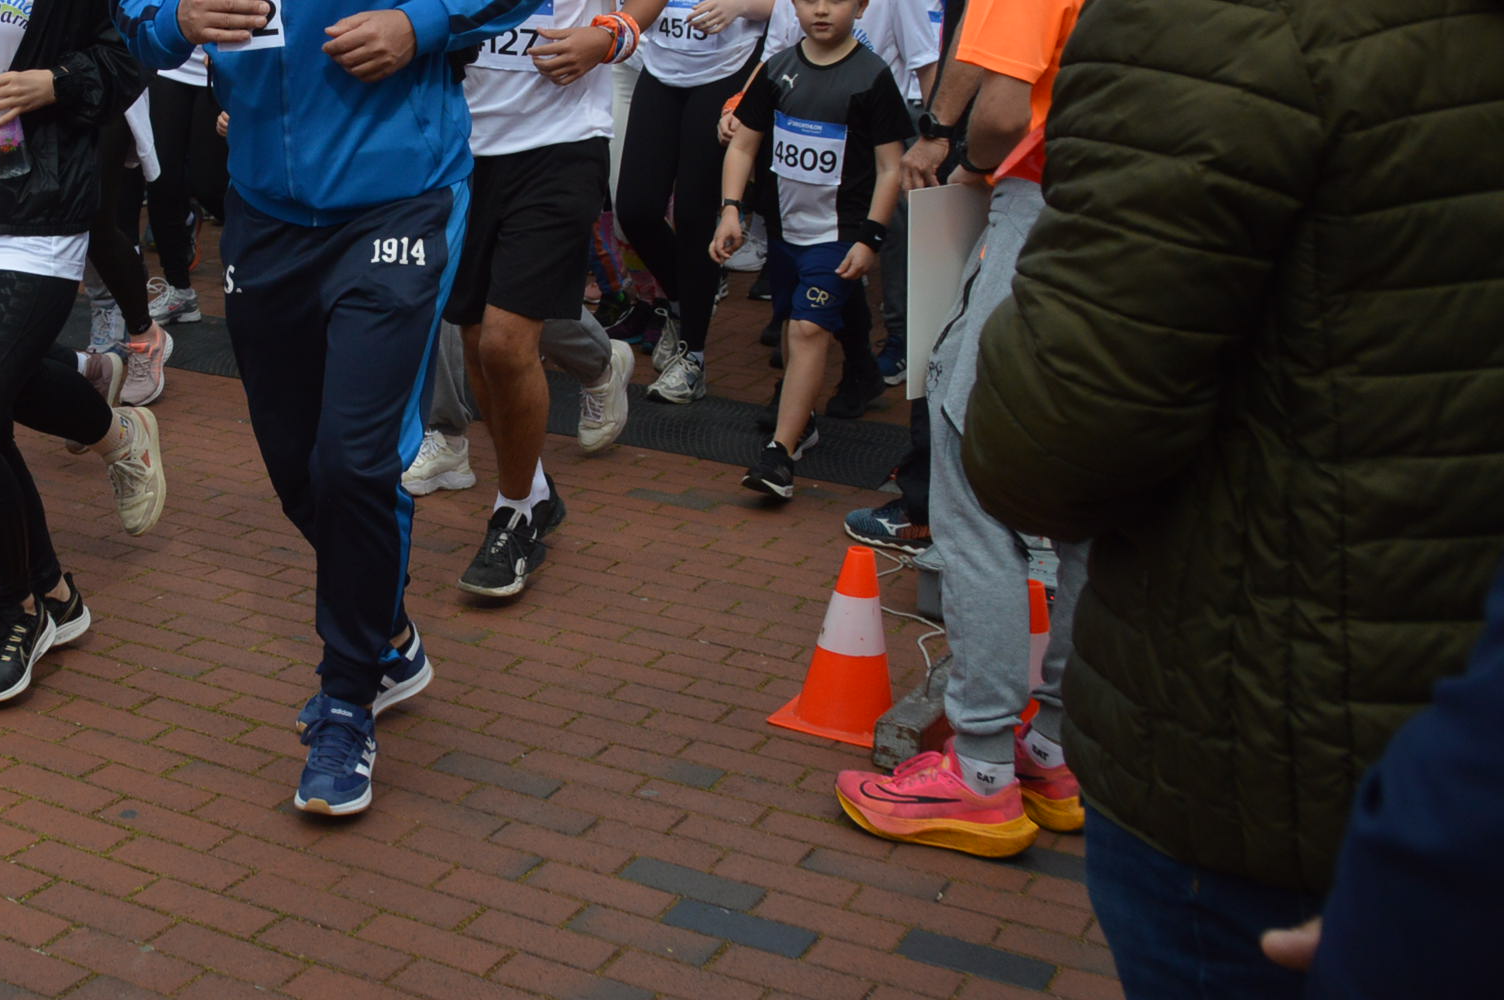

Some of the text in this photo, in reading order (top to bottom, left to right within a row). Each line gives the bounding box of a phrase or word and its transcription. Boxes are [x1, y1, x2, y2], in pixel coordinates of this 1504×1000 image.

[479, 28, 539, 57] 127
[774, 140, 838, 174] 4809
[370, 236, 426, 266] 1914
[976, 771, 996, 785] CAT
